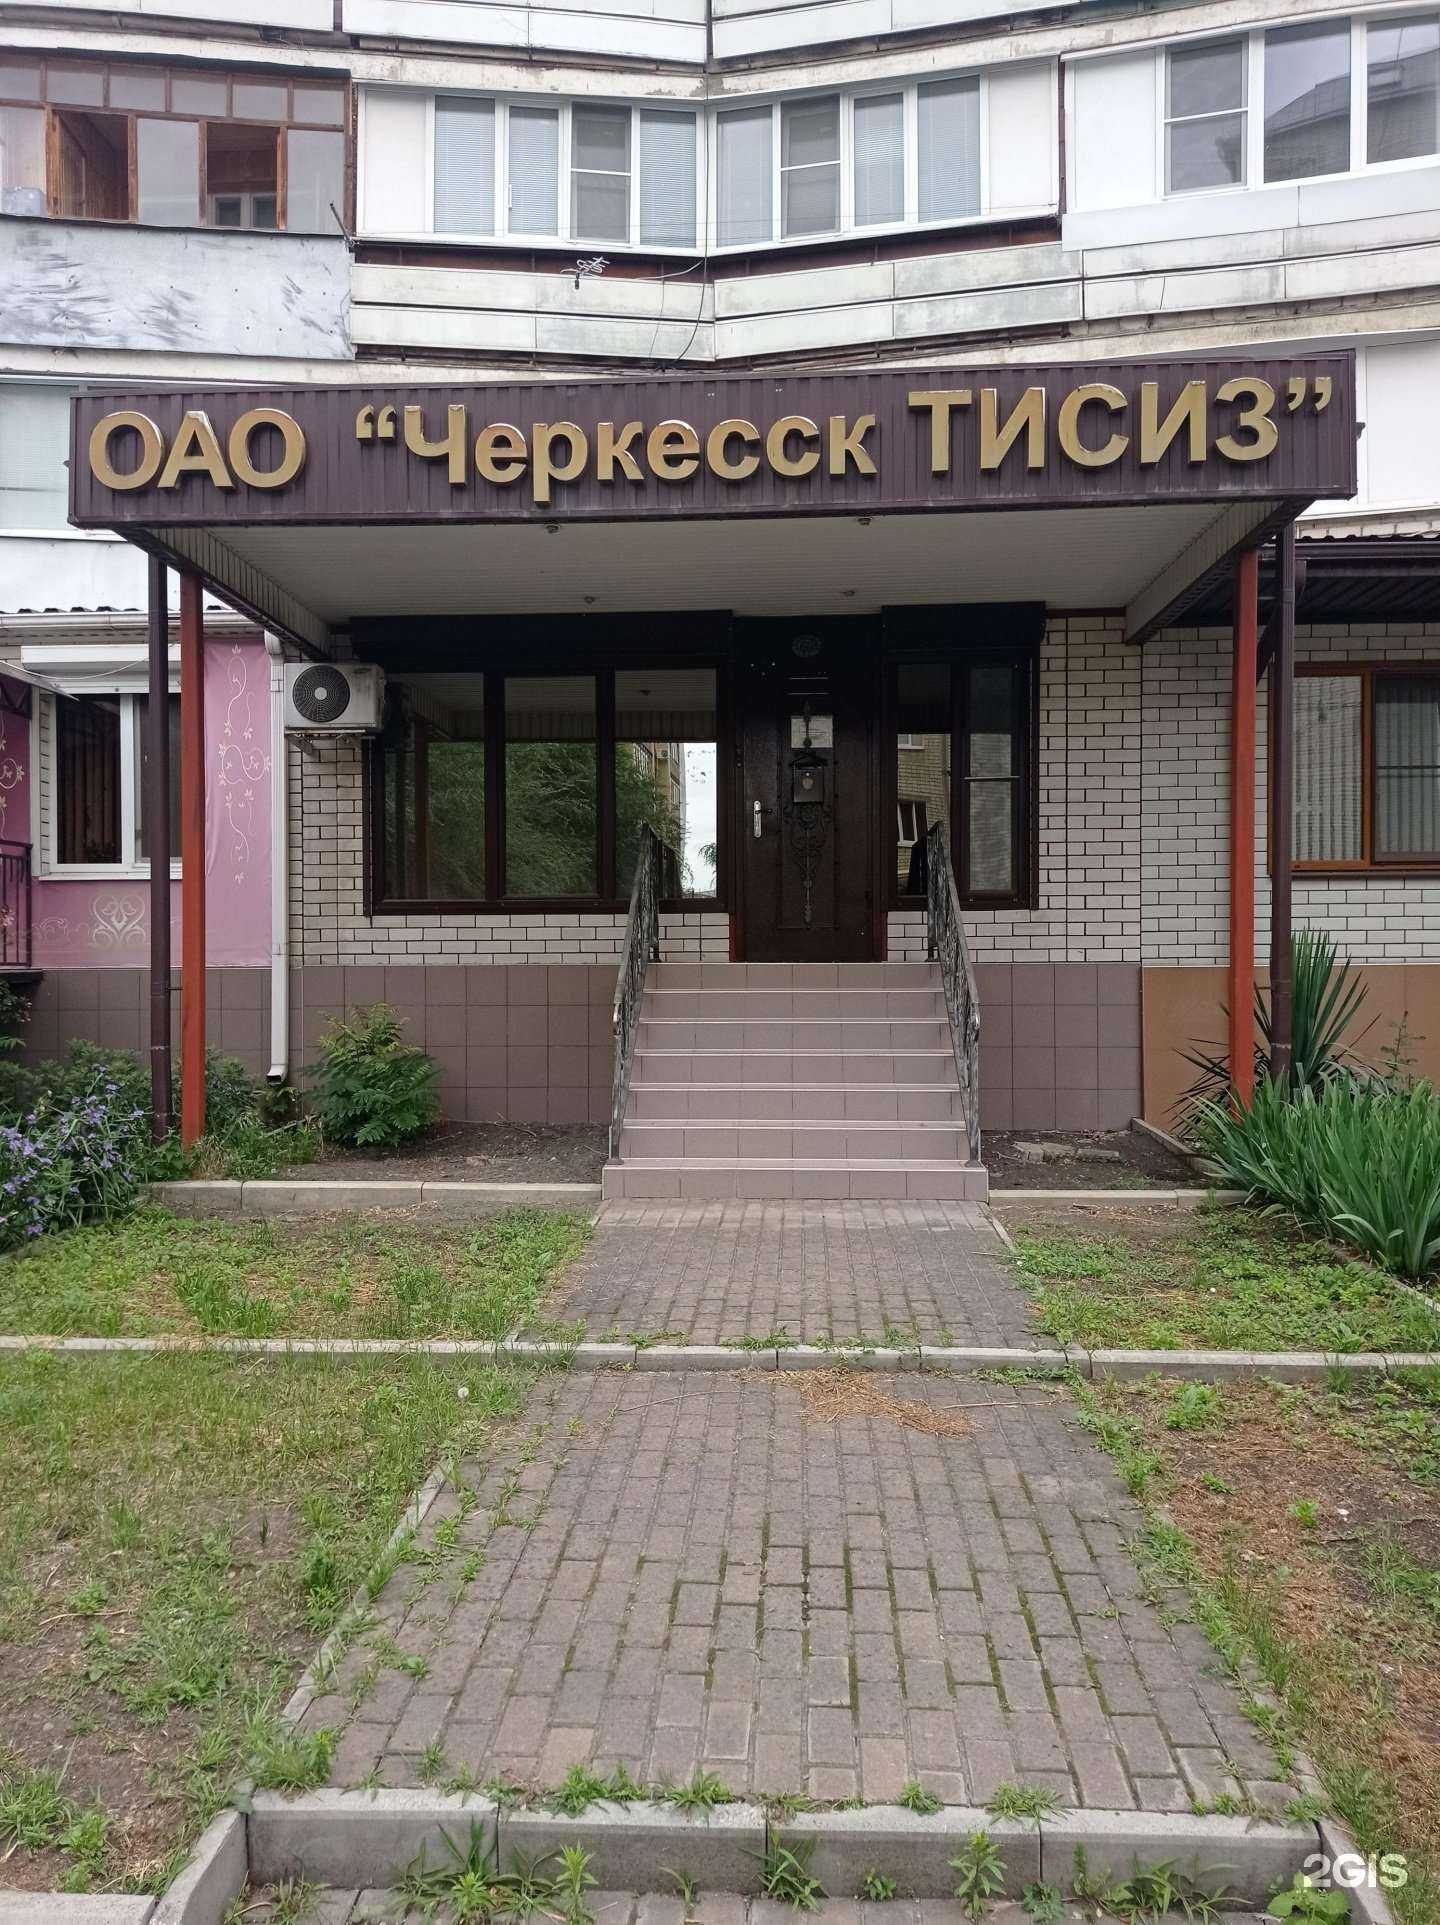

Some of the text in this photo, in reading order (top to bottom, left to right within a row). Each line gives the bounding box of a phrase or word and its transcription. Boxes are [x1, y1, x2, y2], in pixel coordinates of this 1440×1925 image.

[88, 376, 1333, 504] ОАО “Черкесск ТИСИЗ”
